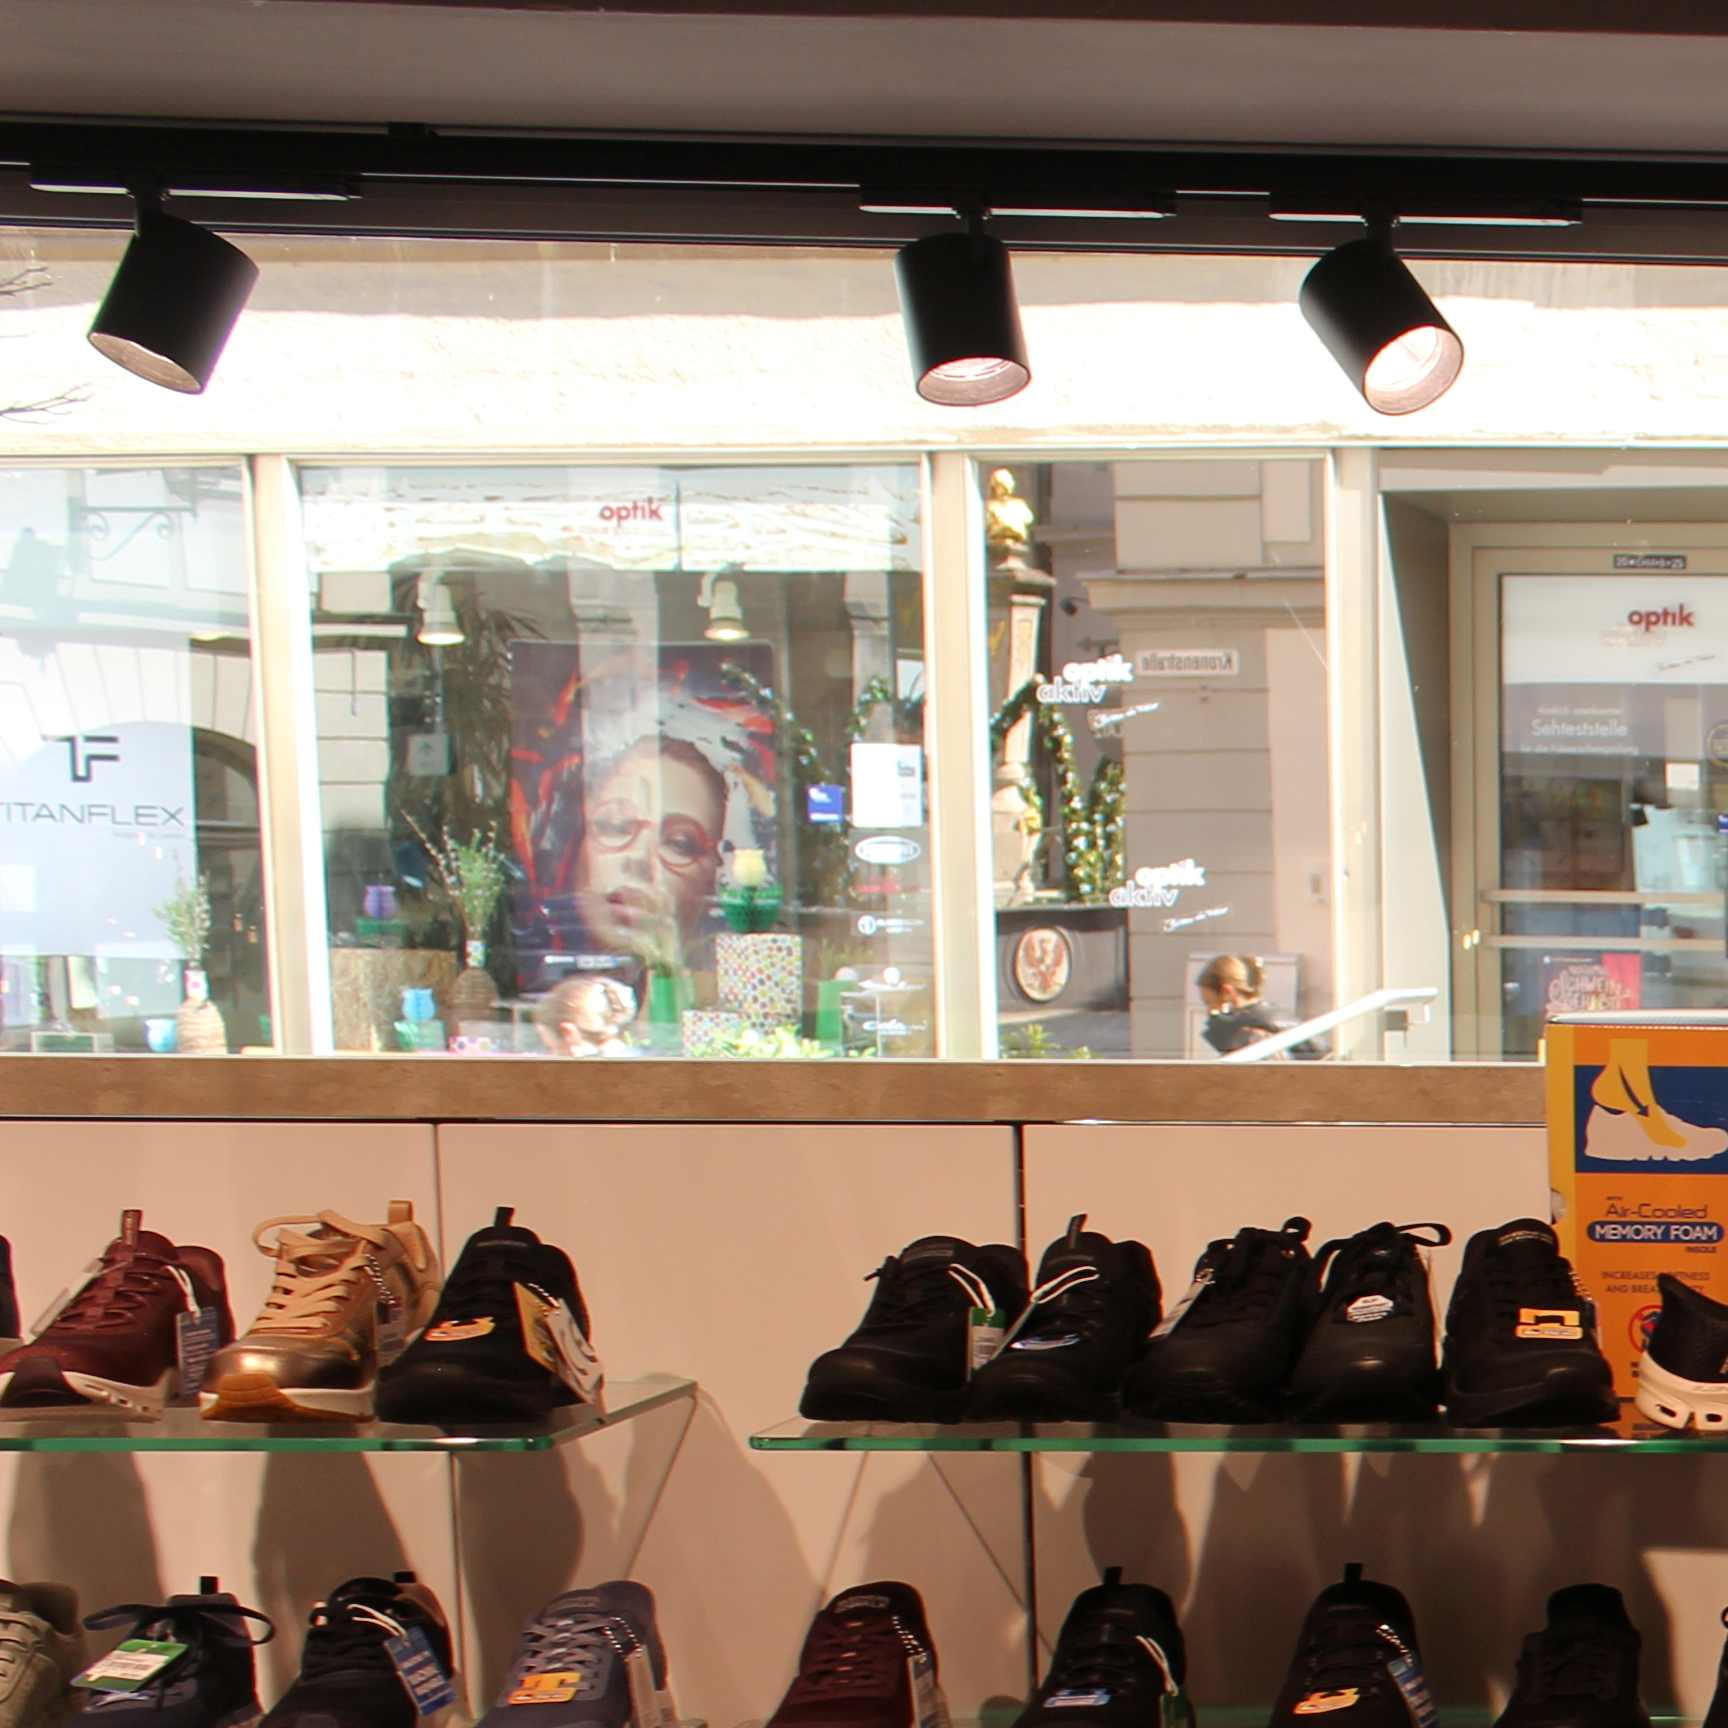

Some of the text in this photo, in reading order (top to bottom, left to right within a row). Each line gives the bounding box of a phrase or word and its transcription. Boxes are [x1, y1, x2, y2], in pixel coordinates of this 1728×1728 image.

[599, 496, 663, 528] optik
[1627, 602, 1696, 633] optik
[0, 801, 185, 827] ITANFLEX
[1604, 1202, 1708, 1219] Air-Cooled
[1594, 1224, 1718, 1241] MEMORY FOAM
